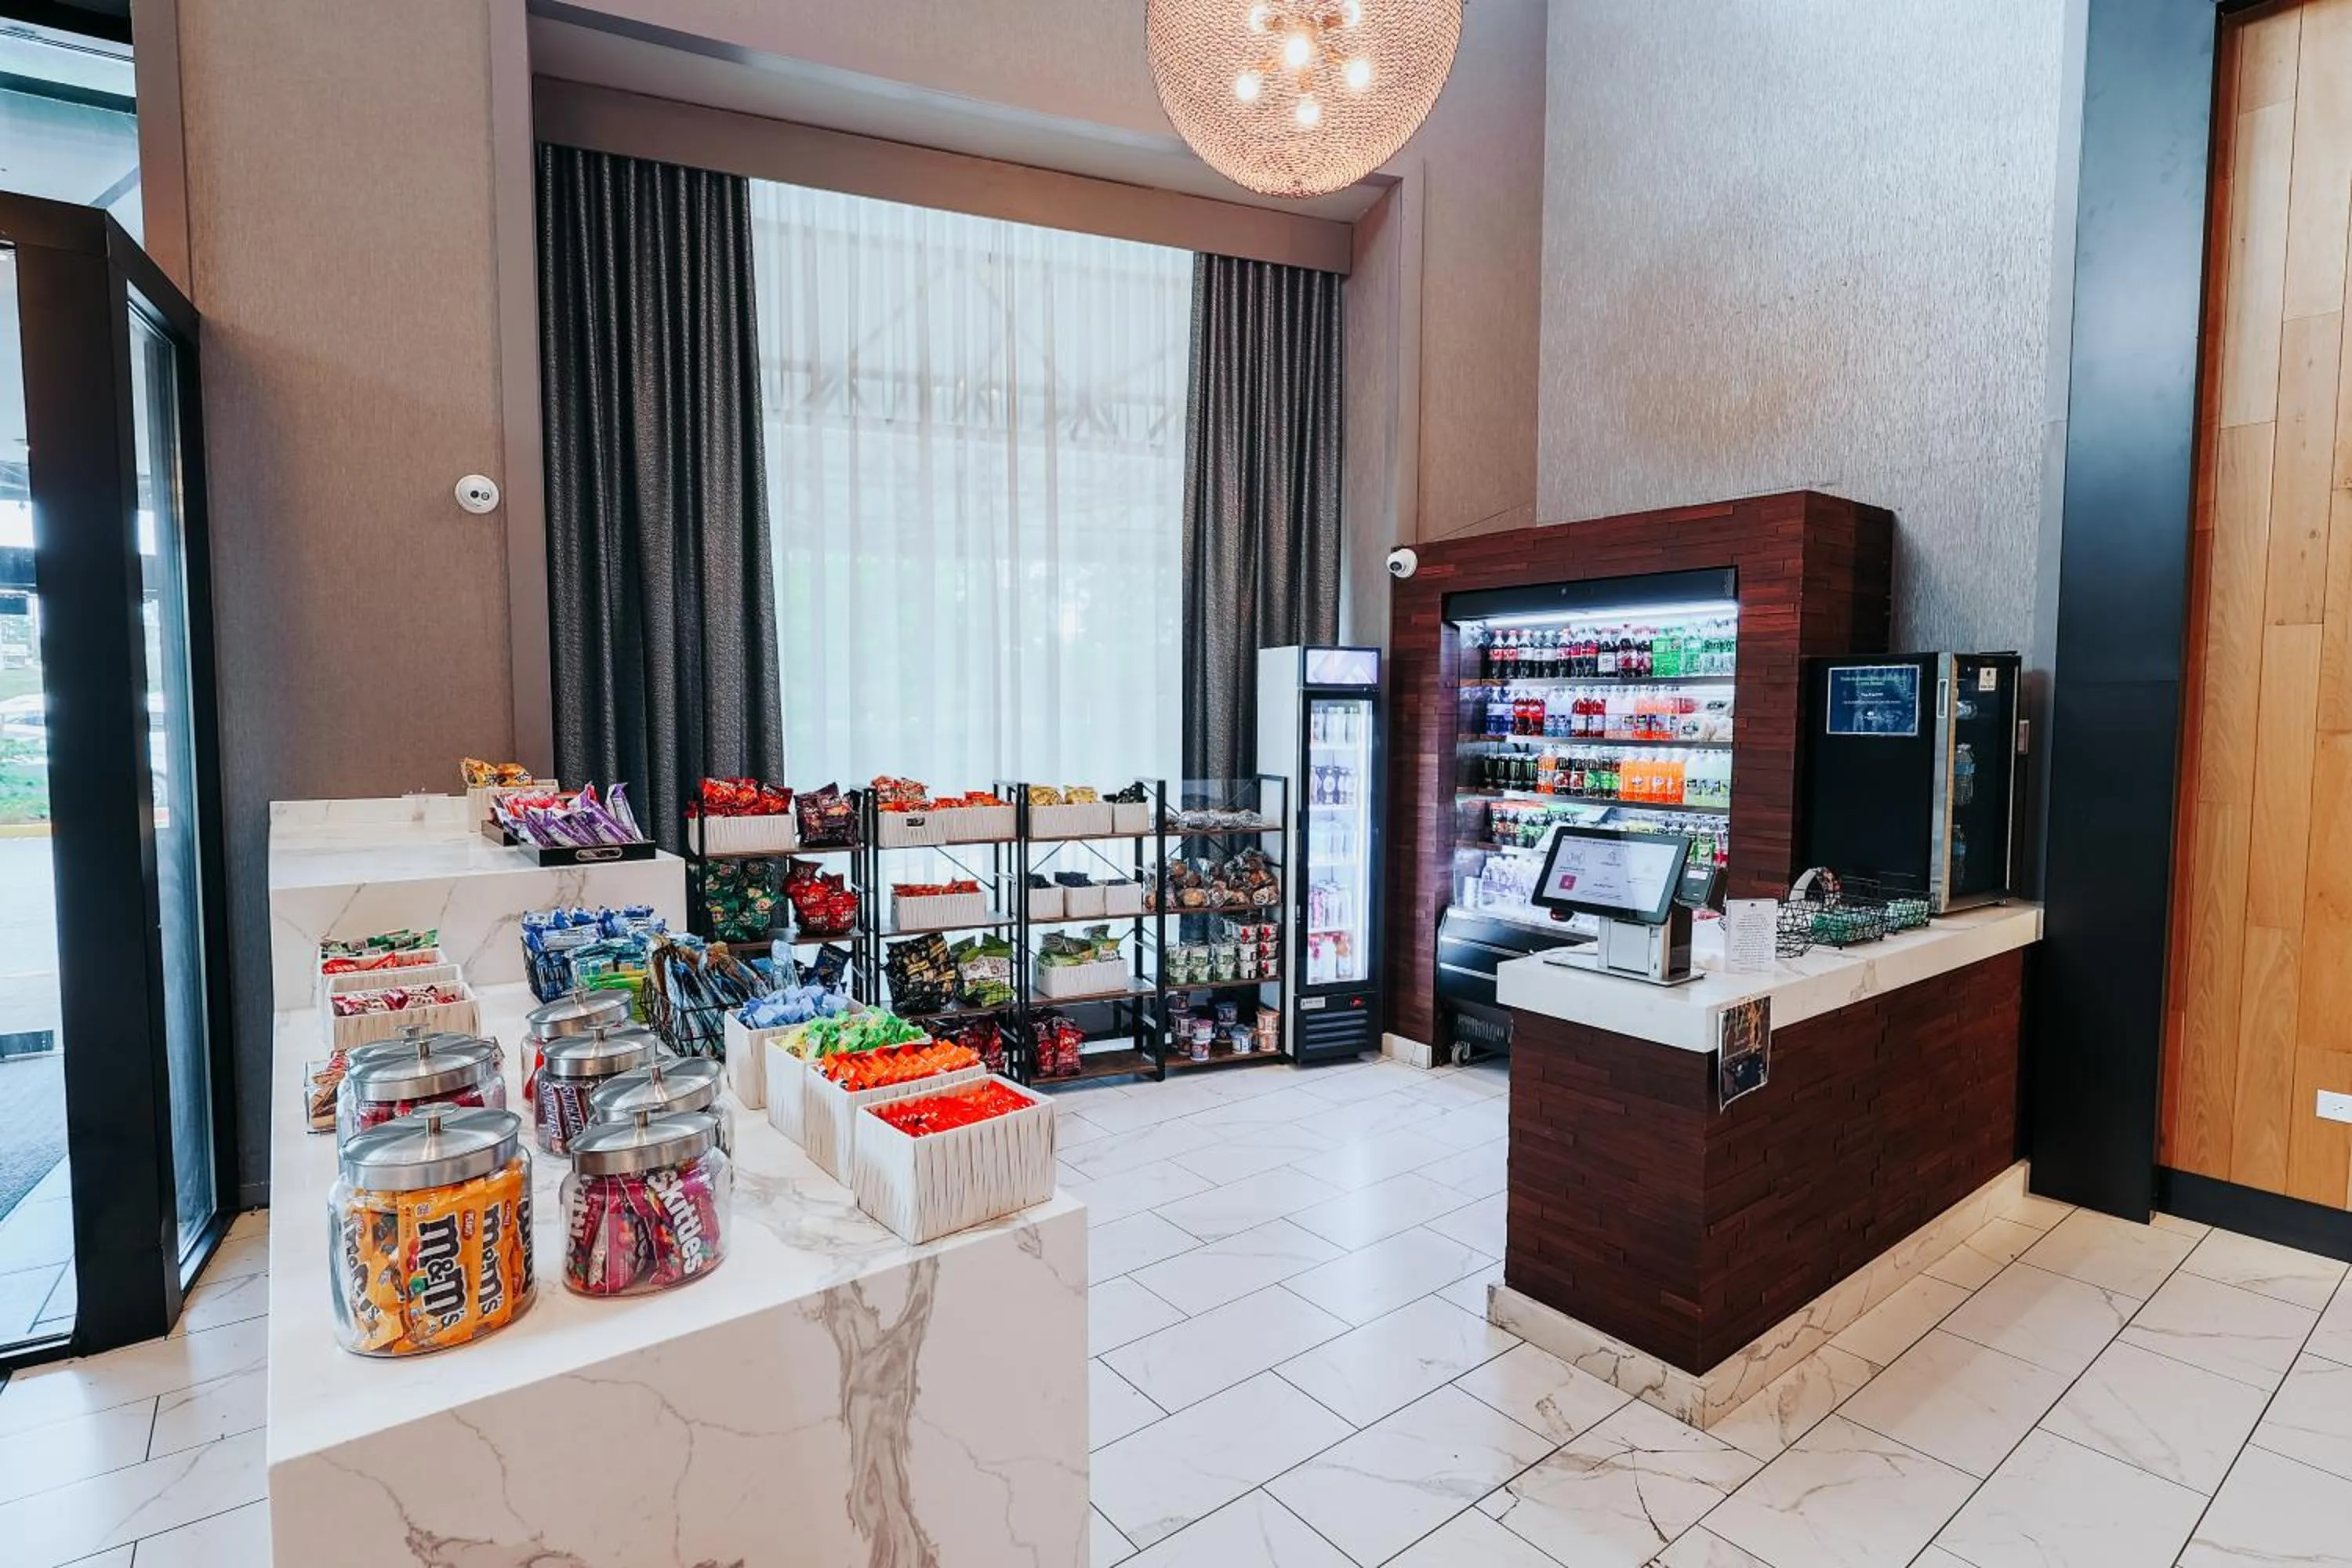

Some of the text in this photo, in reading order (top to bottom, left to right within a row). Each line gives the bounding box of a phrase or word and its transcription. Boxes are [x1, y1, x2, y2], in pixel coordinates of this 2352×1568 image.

[564, 1086, 585, 1136] SNICKERS
[416, 1213, 465, 1328] m&m's
[478, 1203, 504, 1315] m&m's
[646, 1171, 704, 1276] Skittles
